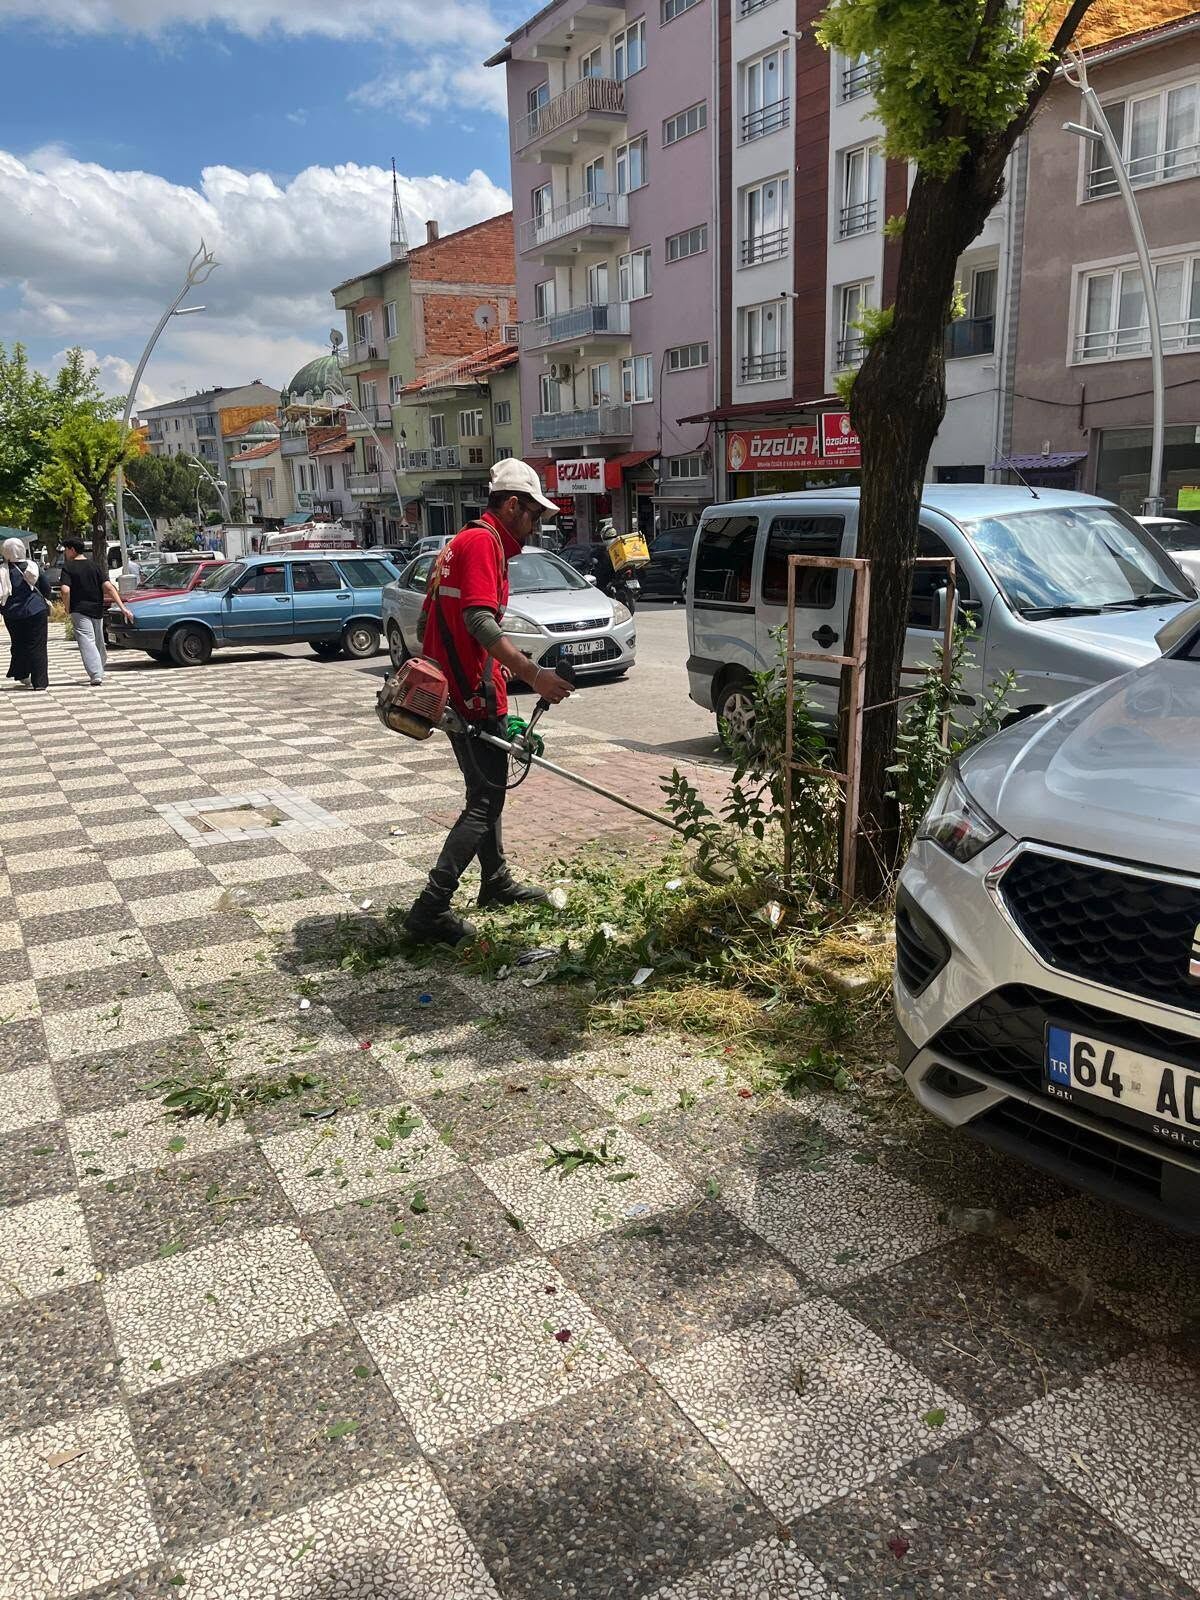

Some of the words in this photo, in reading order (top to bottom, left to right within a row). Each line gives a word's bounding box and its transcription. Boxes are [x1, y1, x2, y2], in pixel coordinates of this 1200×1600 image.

[750, 433, 808, 456] ÖZGÜR
[825, 436, 849, 446] ÖZGÜR
[849, 435, 860, 445] PİL
[558, 462, 600, 480] ECZANE
[578, 642, 591, 652] CYV
[1050, 1058, 1068, 1075] TR
[1073, 1041, 1123, 1098] 64
